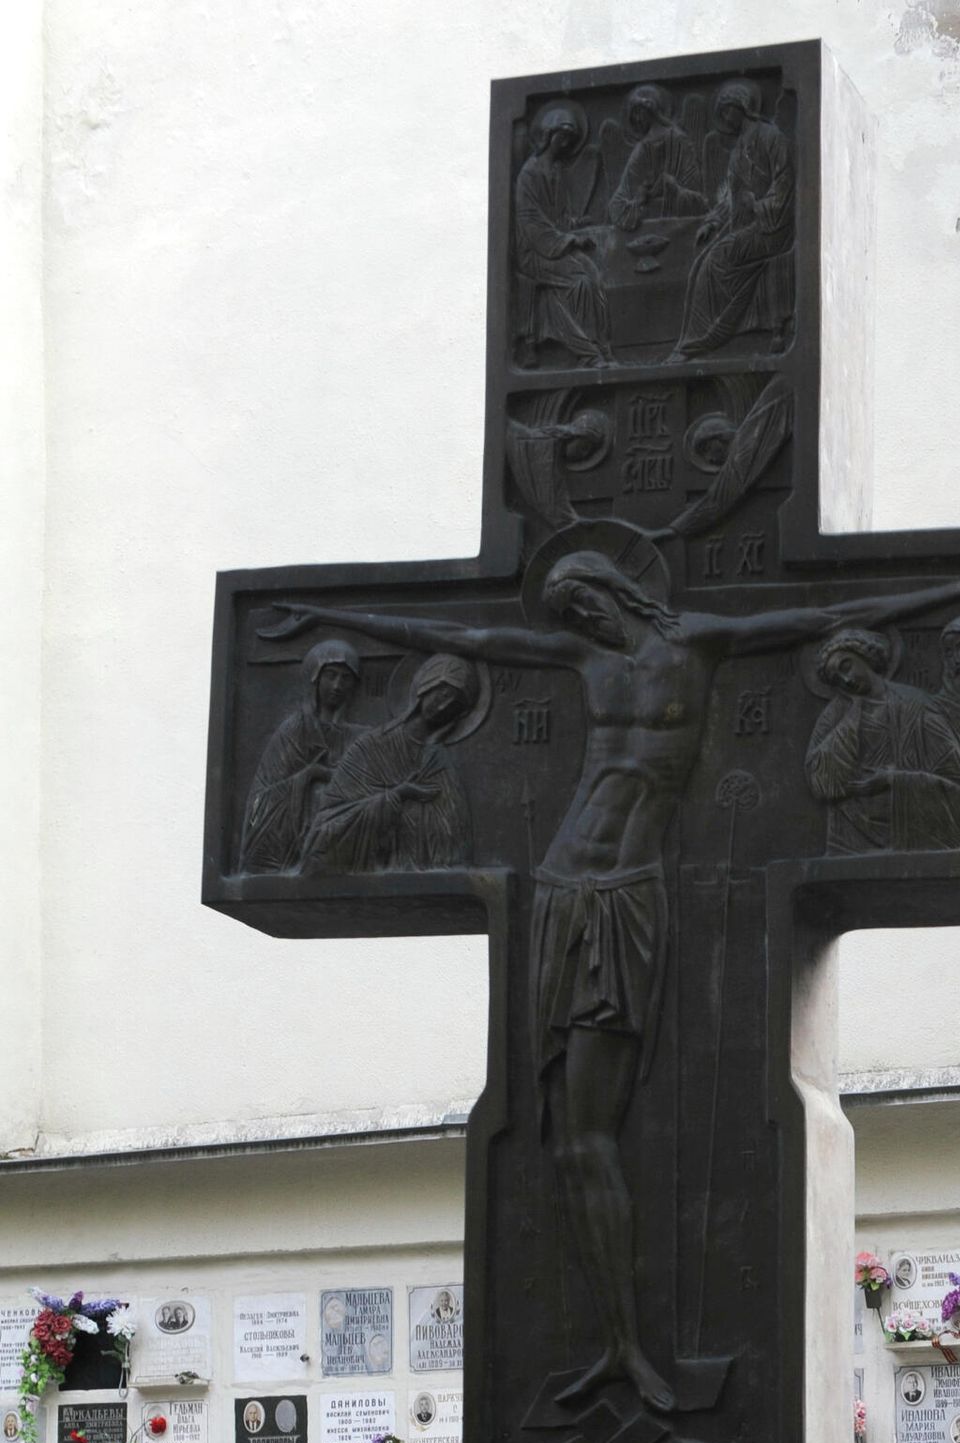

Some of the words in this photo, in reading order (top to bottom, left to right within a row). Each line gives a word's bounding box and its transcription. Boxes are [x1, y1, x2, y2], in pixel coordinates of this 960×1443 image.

[893, 1299, 943, 1311] ВОЙЦЕХОВ
[415, 1324, 463, 1341] ПИВОВАРО
[417, 1349, 463, 1360] АЛЕКСАНДРО
[330, 1398, 386, 1409] ДАНИЛОВЫ
[901, 1409, 946, 1422] ИВАНОВА
[905, 1422, 936, 1431] МАРИЯ
